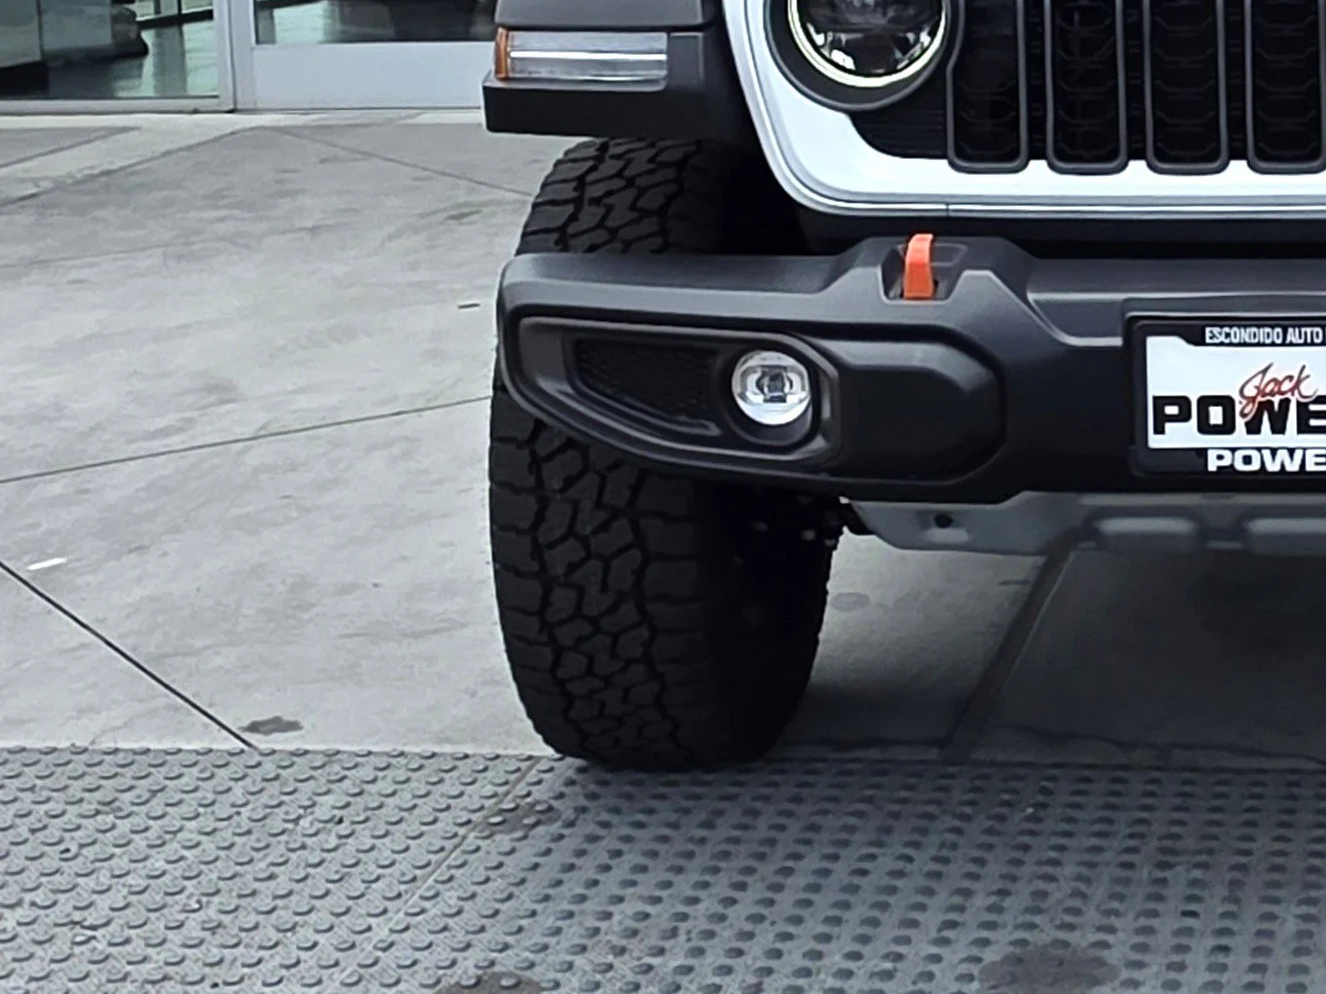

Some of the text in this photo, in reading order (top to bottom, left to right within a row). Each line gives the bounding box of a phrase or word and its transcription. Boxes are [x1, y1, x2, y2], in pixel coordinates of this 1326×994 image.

[1205, 327, 1283, 344] ESCONDIDO
[1286, 327, 1322, 344] AUTO
[1239, 362, 1319, 422] Jack
